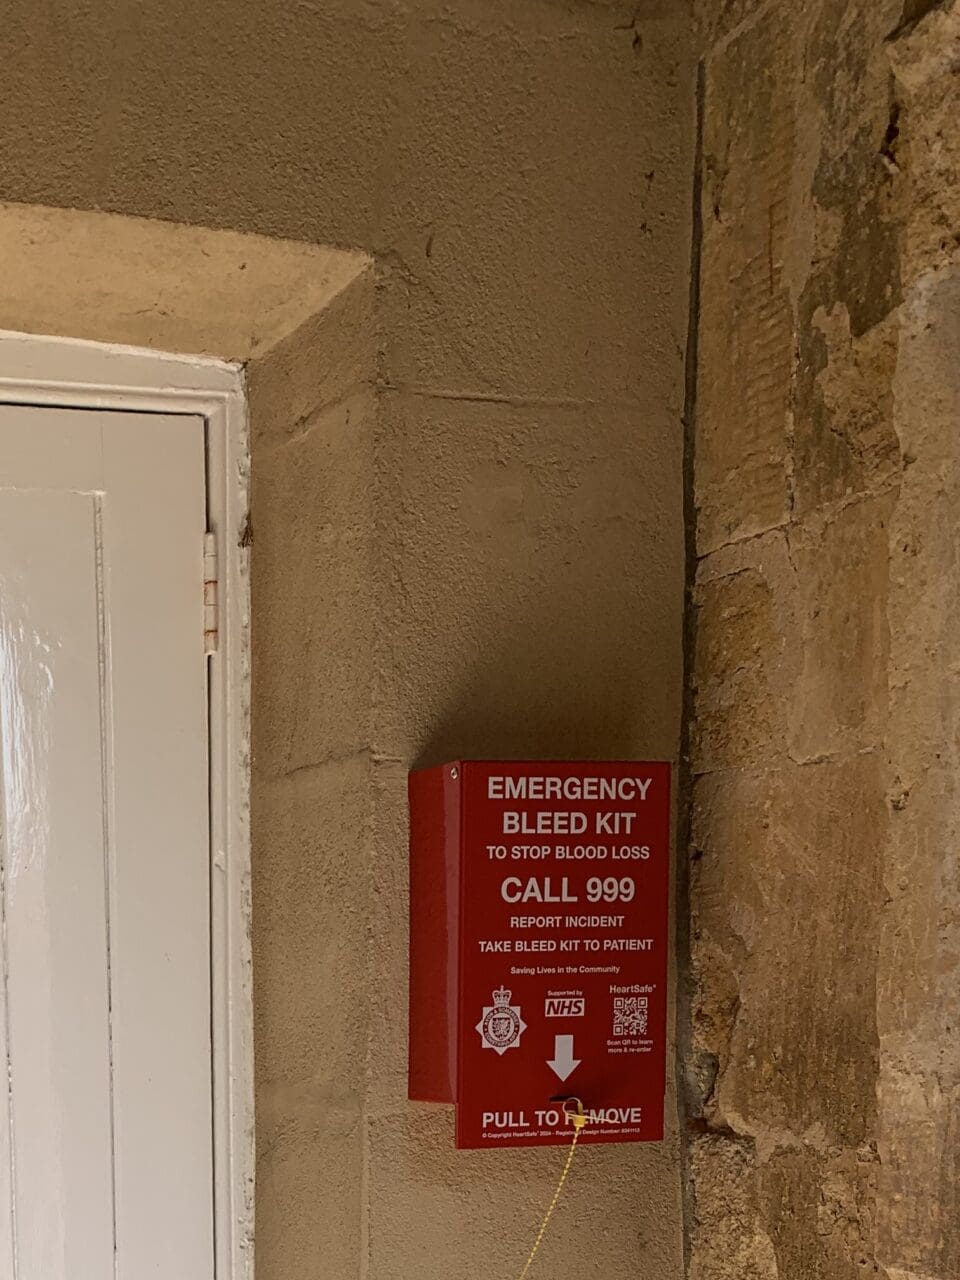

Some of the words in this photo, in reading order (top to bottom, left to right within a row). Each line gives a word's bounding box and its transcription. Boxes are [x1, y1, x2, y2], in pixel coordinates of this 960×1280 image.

[488, 776, 652, 800] EMERGENCY
[503, 812, 587, 834] BLEED
[596, 812, 636, 834] KIT
[487, 846, 506, 859] TO
[511, 846, 551, 859] STOP
[555, 846, 607, 859] BLOOD
[612, 846, 650, 859] LOSS
[501, 877, 578, 903] CALL
[586, 877, 635, 902] 999
[510, 916, 562, 928] REPORT
[565, 916, 625, 928] INCIDENT
[479, 941, 511, 952] TAKE
[515, 940, 556, 952] BLEED
[560, 940, 580, 951] KIT
[584, 939, 600, 951] TO
[604, 939, 653, 951] PATIENT
[511, 966, 535, 975] Saving
[579, 965, 620, 974] Community
[547, 1000, 583, 1015] NHS
[482, 1112, 530, 1128] PULL
[535, 1110, 559, 1126] TO
